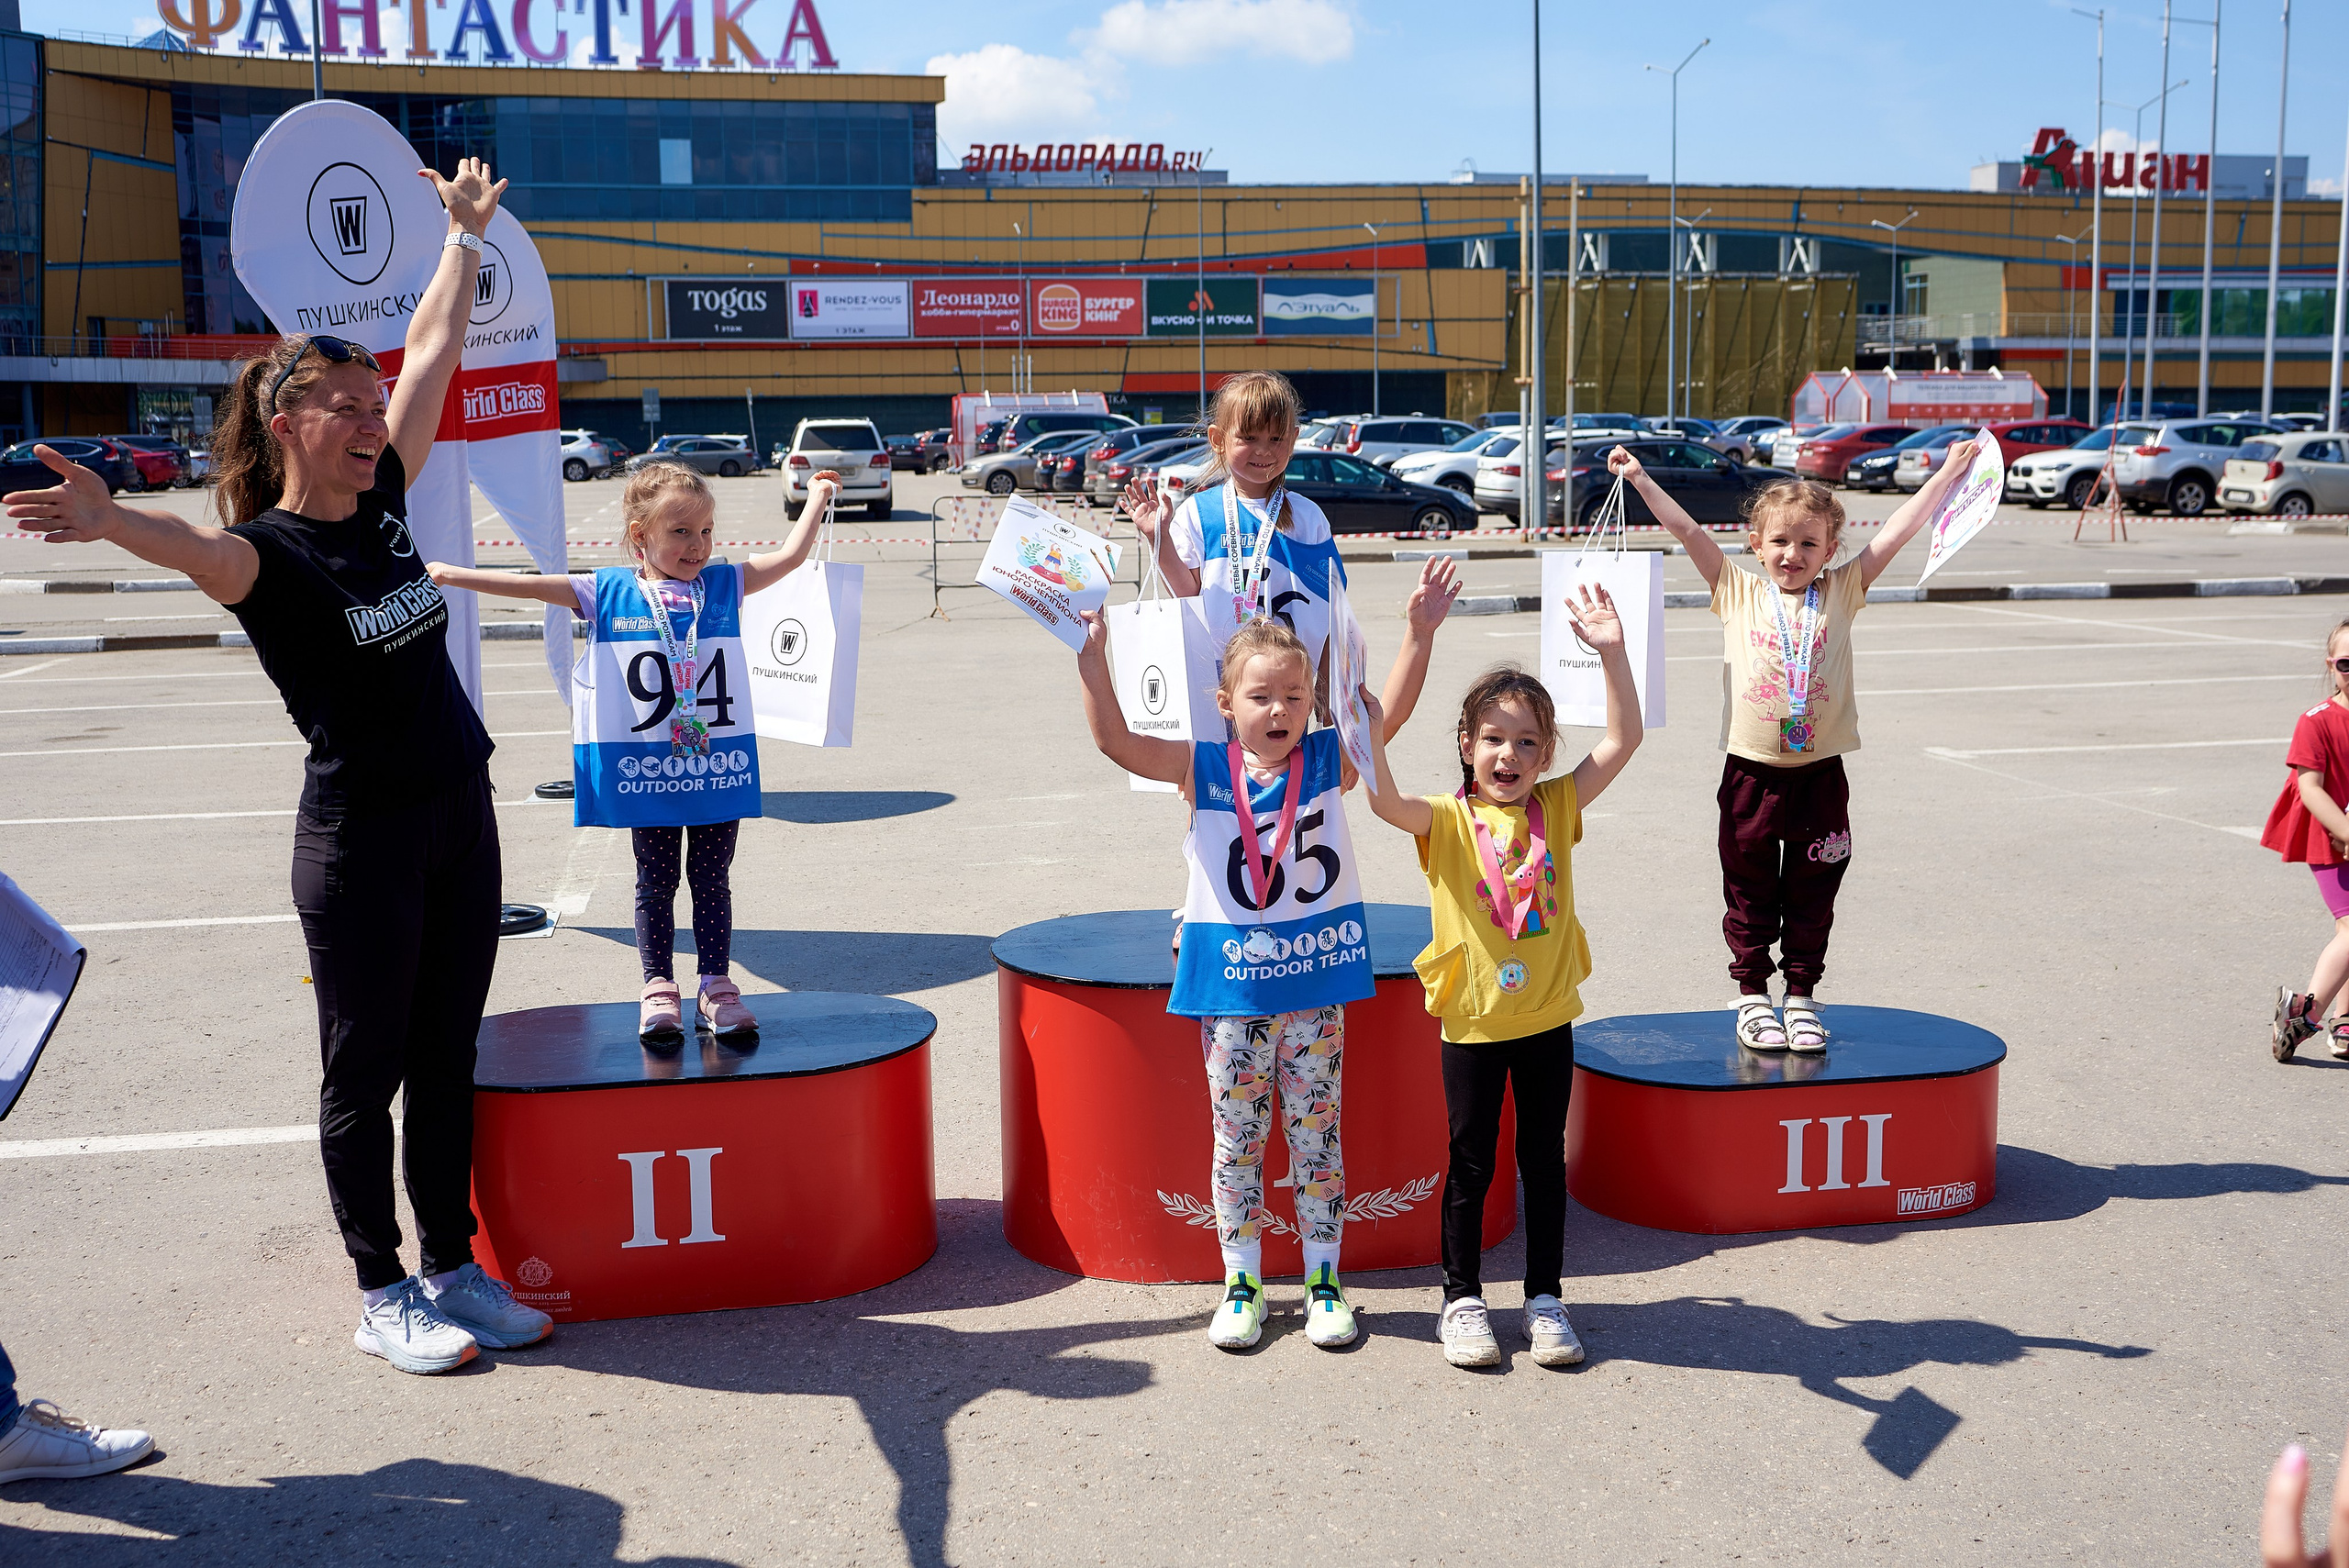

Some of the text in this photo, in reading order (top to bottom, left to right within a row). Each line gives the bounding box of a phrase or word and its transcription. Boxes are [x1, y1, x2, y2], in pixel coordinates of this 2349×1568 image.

[159, 0, 839, 70] ФАНТАСТИКА
[919, 289, 1020, 309] Леонардо
[1041, 299, 1078, 307] BURGER
[1041, 308, 1078, 320] KING
[1085, 297, 1135, 309] БУРГЕР
[1085, 310, 1120, 322] КИНГ
[463, 324, 540, 349] КИНСКИЙ
[1151, 316, 1195, 325] ВКУСНО
[1217, 315, 1253, 325] ТОЧКА
[463, 385, 545, 419] orld Class
[1950, 482, 1987, 523] ДИПЛОМ
[1228, 508, 1239, 562] СОРЕВНОВАНИЯ
[1253, 539, 1267, 574] РОЛИКАМ
[1015, 569, 1070, 606] РАСКРАСКА
[1230, 563, 1241, 595] СЕТЕВЫЕ
[992, 565, 1083, 628] ЮНОГО ЧЕМПИОНА
[1011, 585, 1058, 624] World Class
[351, 596, 410, 639] World
[384, 609, 447, 653] ПУШКИНСКИЙ
[614, 618, 638, 630] World
[661, 620, 677, 657] РОЛИКАМ
[1800, 631, 1810, 666] РОЛИКАМ
[752, 666, 818, 684] ПУШКИНСКИЙ
[1560, 659, 1601, 669] ПУШКИН
[627, 647, 736, 733] 94
[1133, 718, 1180, 729] ПУШКИНСКИЙ
[618, 772, 751, 794] OUTDOOR TEAM
[1226, 808, 1341, 911] 65
[1223, 946, 1366, 981] OUTDOOR TEAM
[1777, 1113, 1892, 1194] III
[618, 1147, 726, 1249] II
[1901, 1184, 1975, 1211] World Class
[510, 1290, 571, 1300] УШКИНСКИЙ
